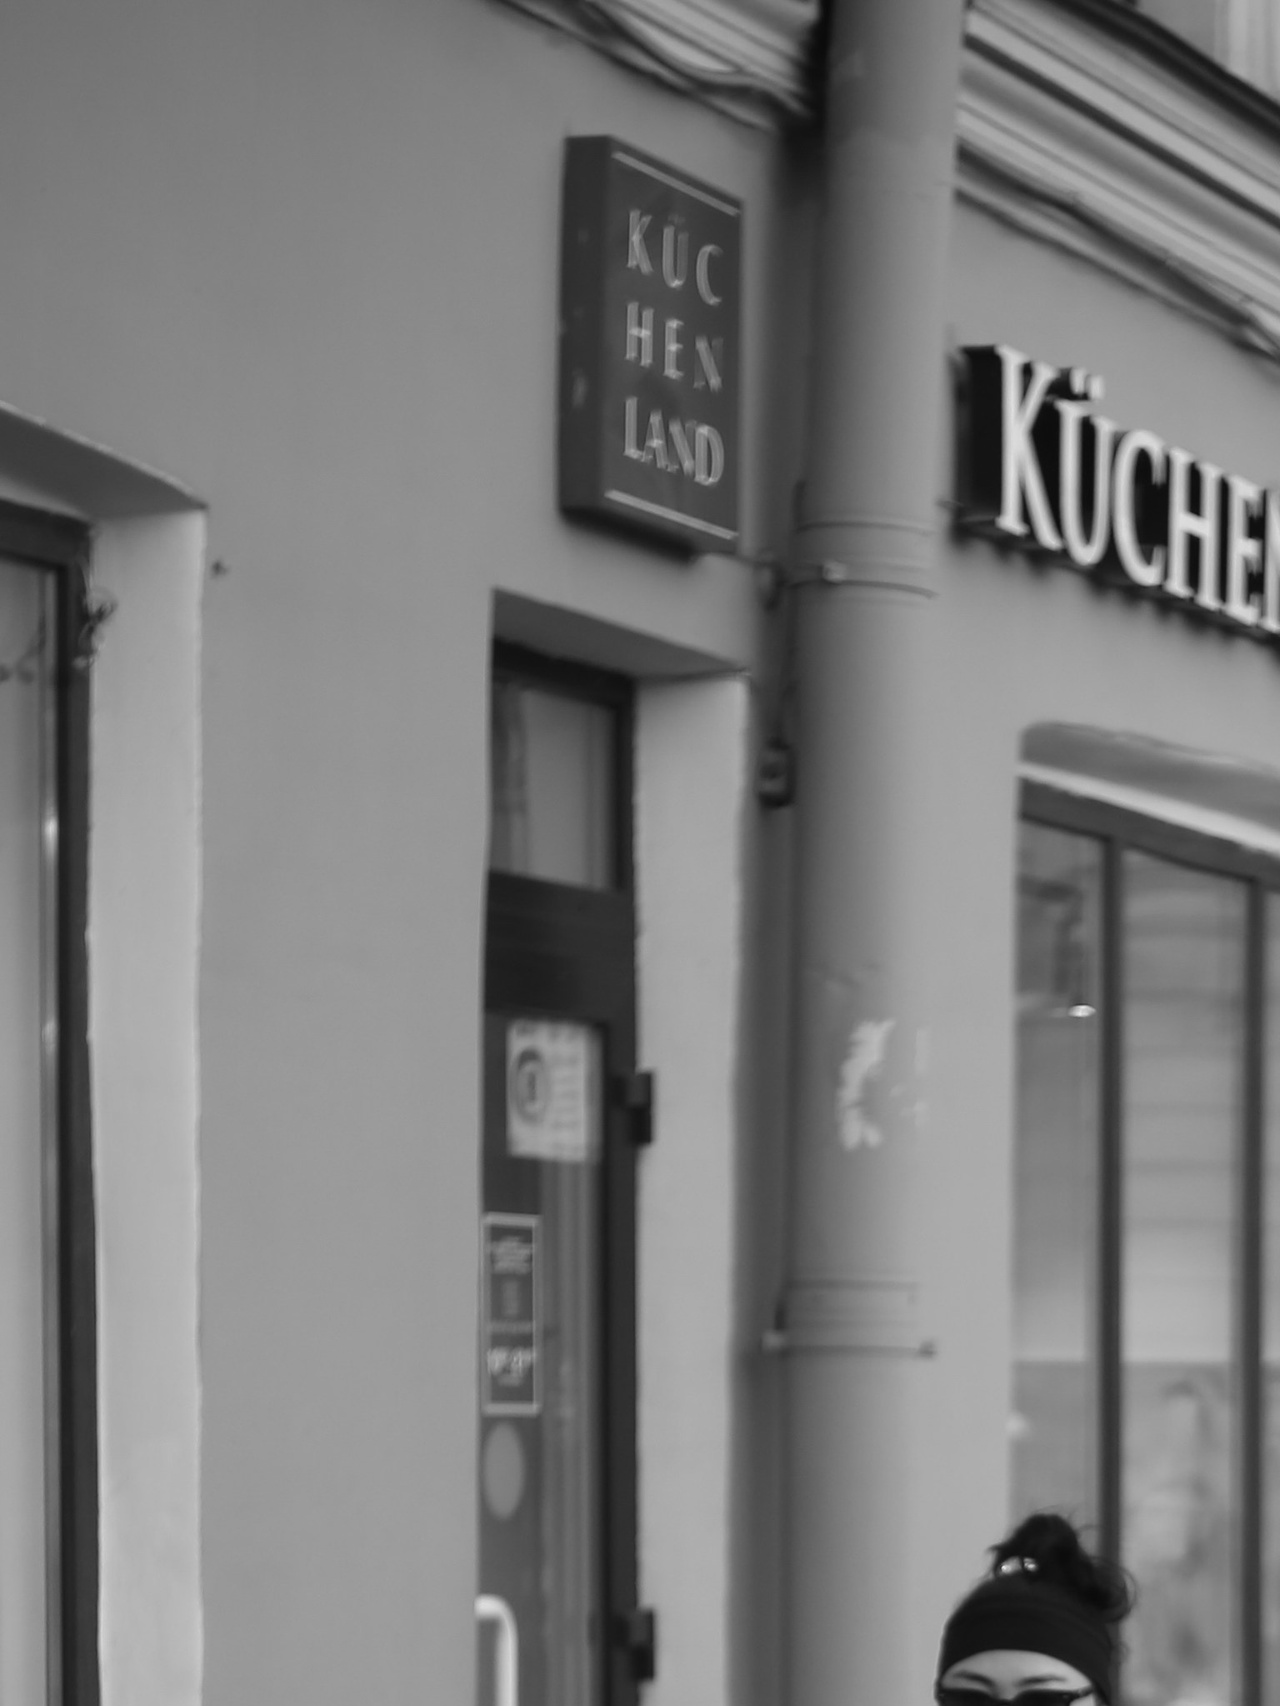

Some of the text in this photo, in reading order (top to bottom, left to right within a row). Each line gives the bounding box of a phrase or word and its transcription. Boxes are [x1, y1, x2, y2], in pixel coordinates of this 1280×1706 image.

[627, 208, 724, 306] KÜC
[625, 302, 724, 392] HEN
[624, 396, 725, 487] LAND
